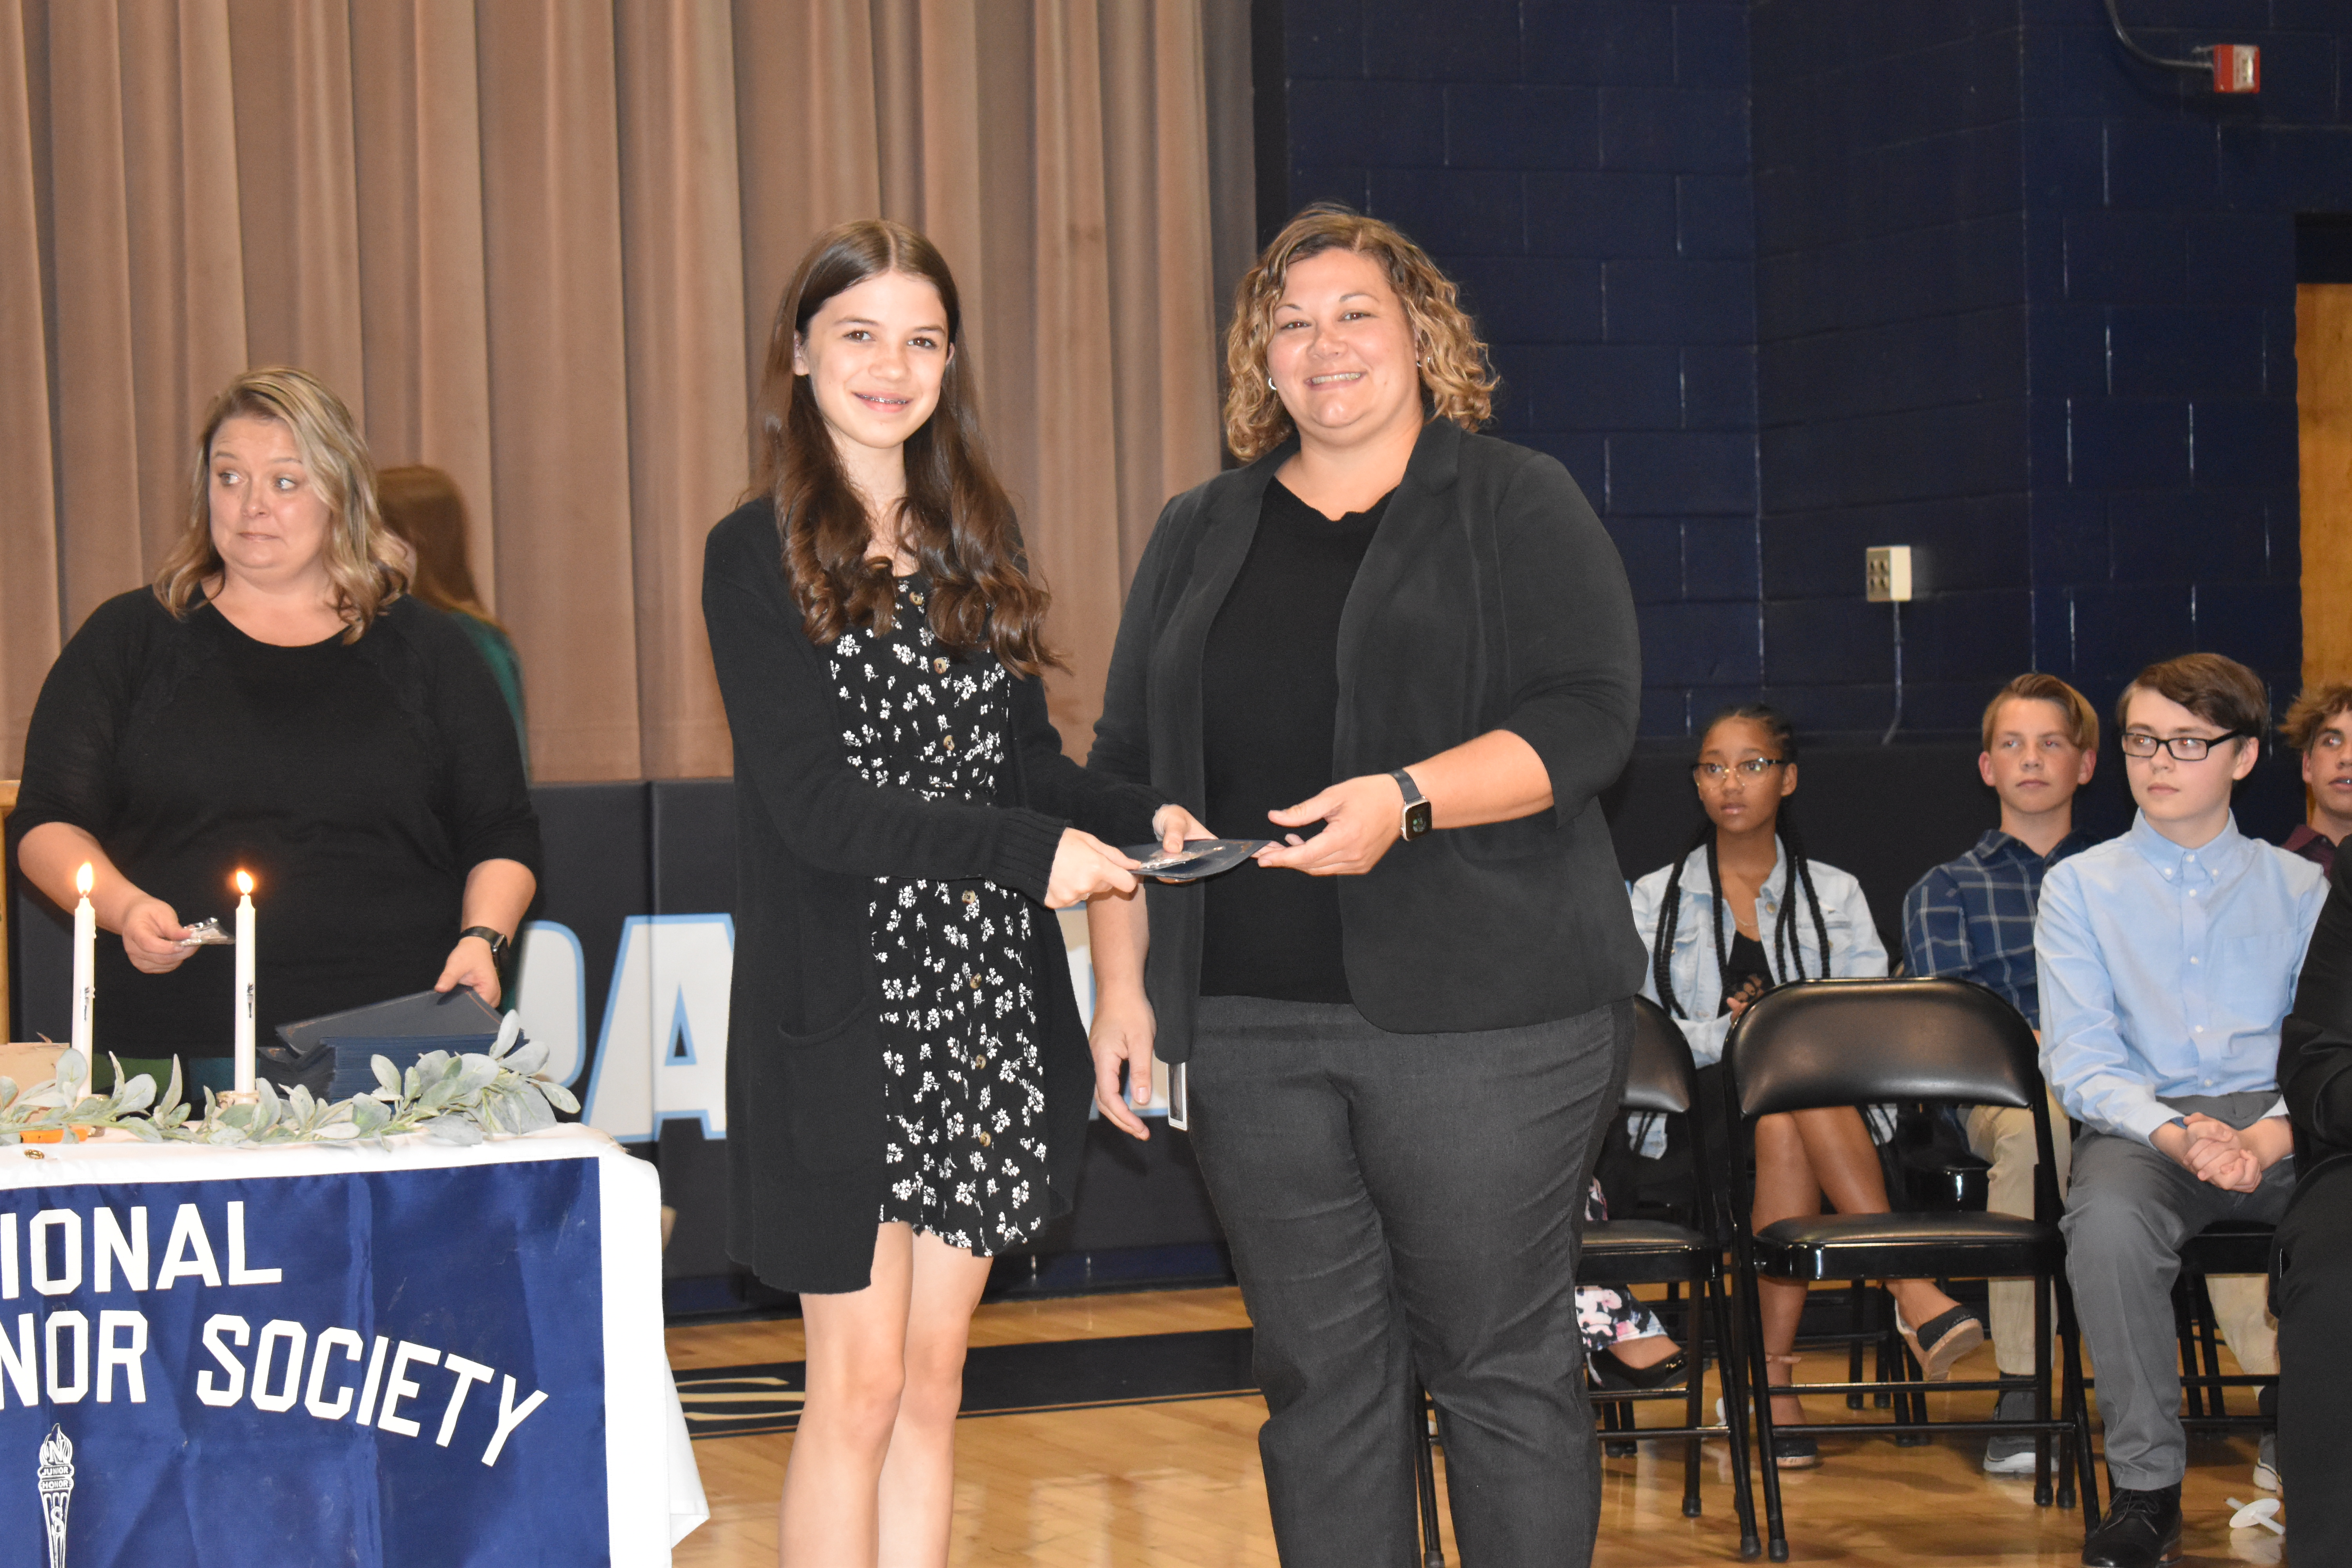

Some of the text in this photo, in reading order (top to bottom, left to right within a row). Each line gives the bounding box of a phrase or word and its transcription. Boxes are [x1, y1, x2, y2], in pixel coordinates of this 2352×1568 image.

[0, 1201, 282, 1299] IONAL
[0, 1310, 548, 1467] NOR SOCIETY
[48, 1439, 65, 1463] N
[42, 1466, 69, 1475] JUNIOR
[42, 1480, 69, 1489] HONOR
